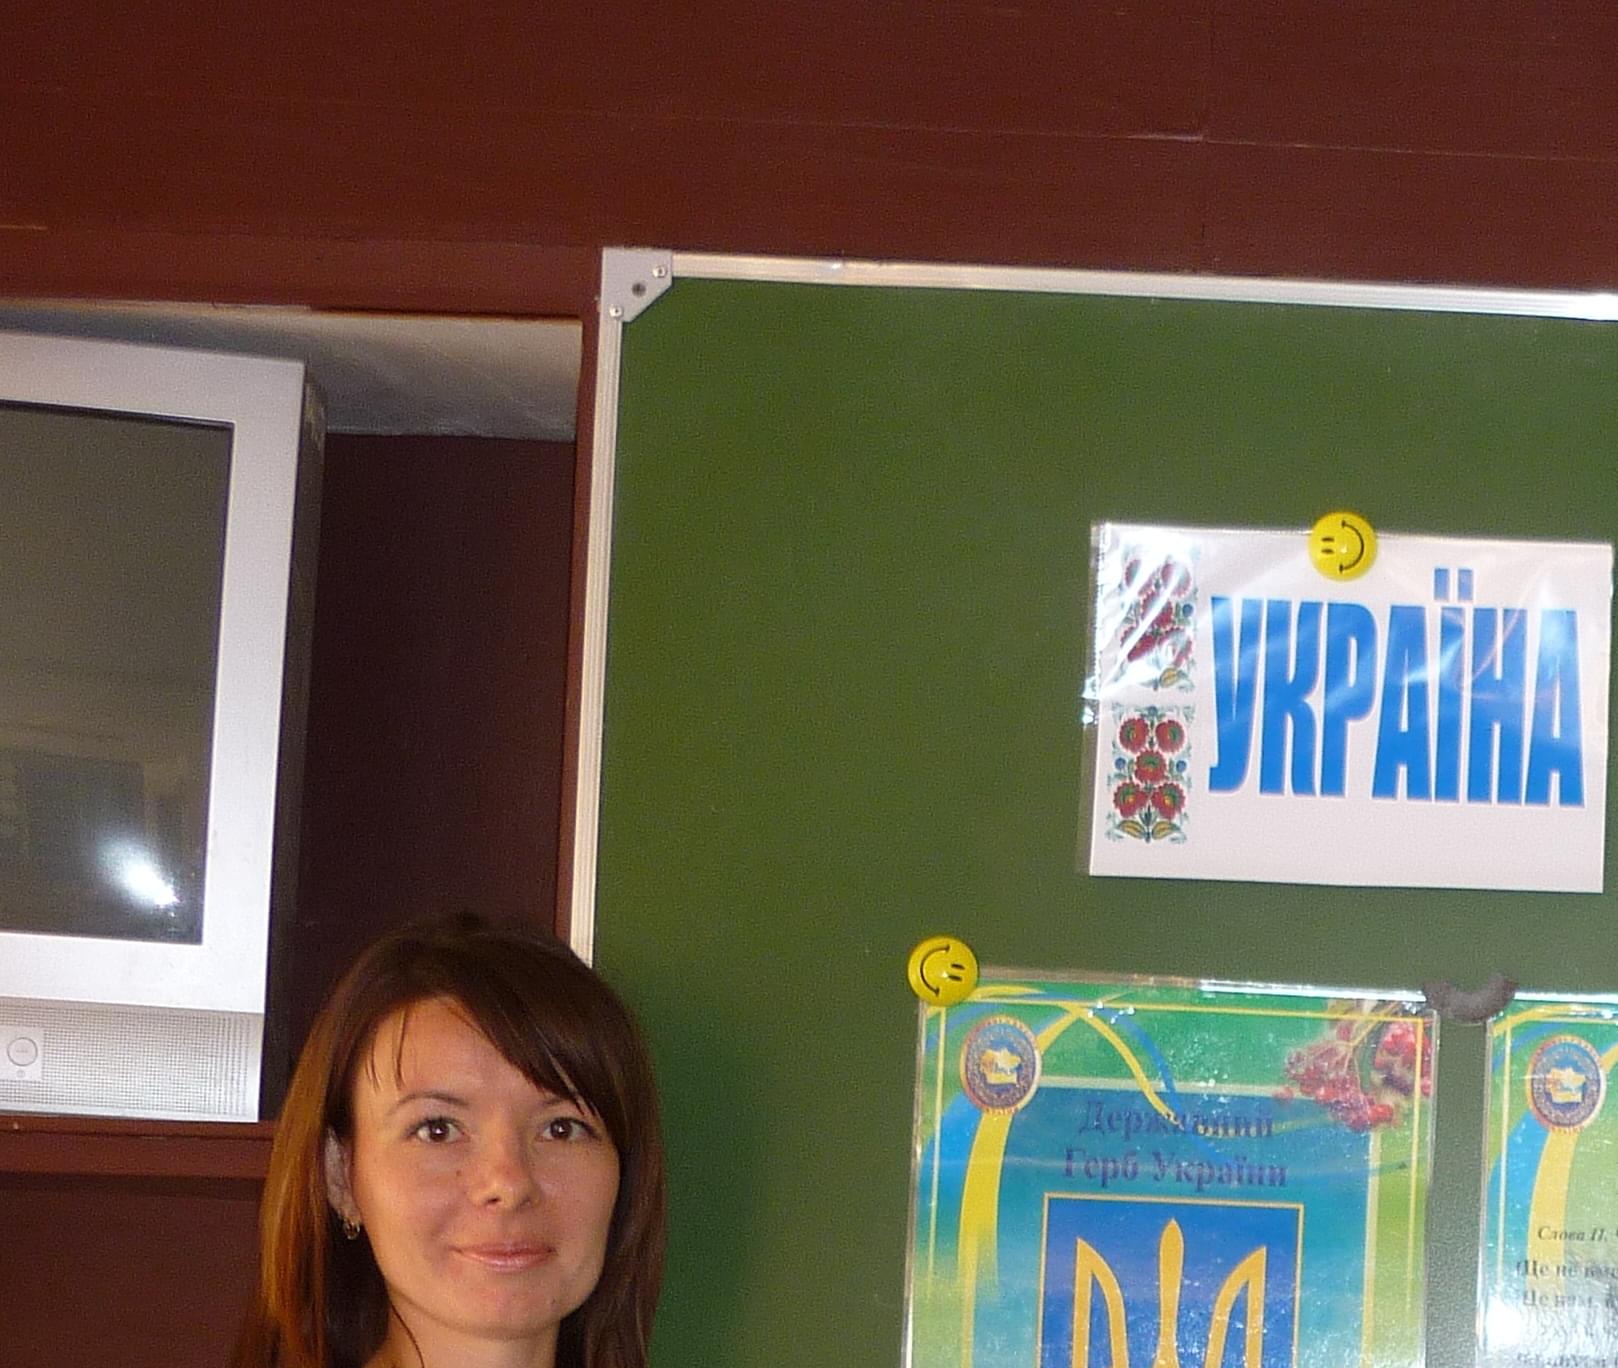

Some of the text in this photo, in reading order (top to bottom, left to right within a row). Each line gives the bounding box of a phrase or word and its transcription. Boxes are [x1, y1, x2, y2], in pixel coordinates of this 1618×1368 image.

[1208, 568, 1585, 807] УКРАЇНА
[1079, 1098, 1273, 1141] Державний
[1065, 1149, 1288, 1192] Герб України
[1537, 1225, 1584, 1241] Слова
